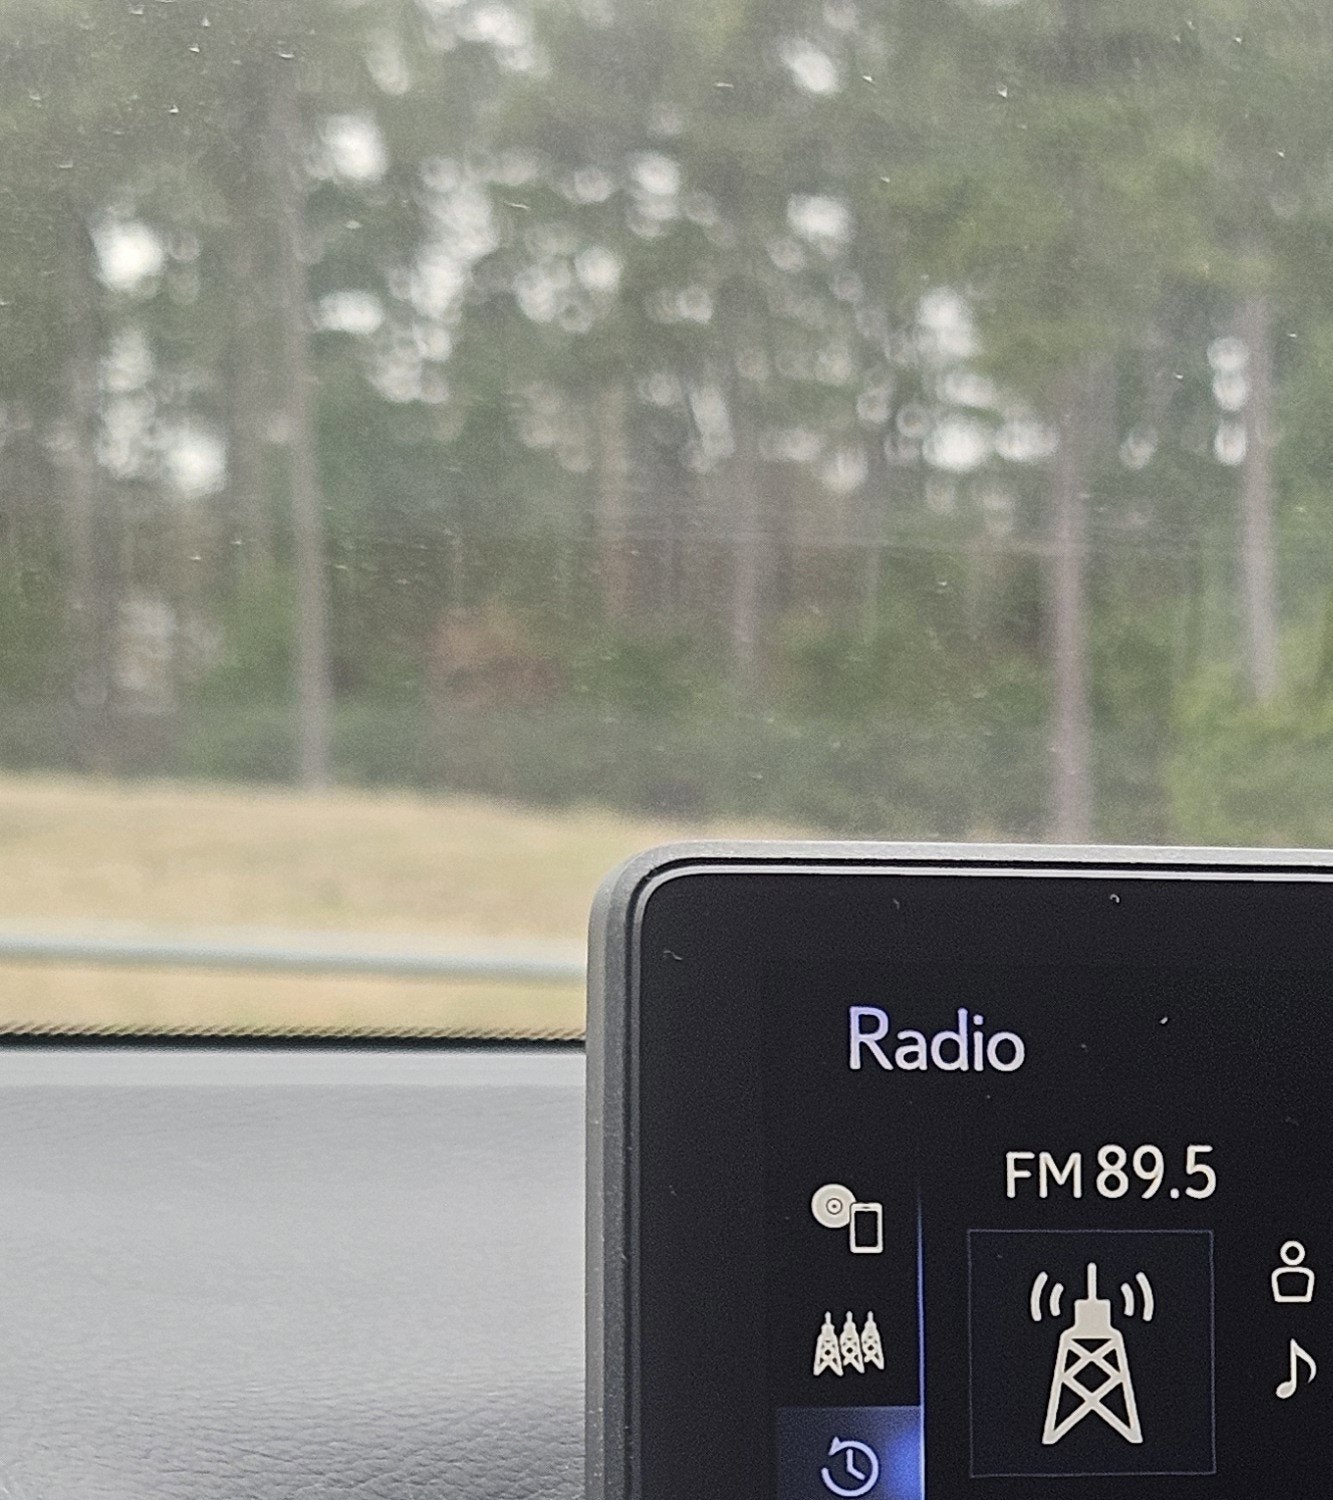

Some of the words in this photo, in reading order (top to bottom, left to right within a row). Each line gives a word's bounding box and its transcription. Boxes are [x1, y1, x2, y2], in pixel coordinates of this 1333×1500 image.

[849, 1006, 1026, 1072] Radio
[1006, 1151, 1083, 1199] FM
[1096, 1144, 1217, 1199] 89.5
